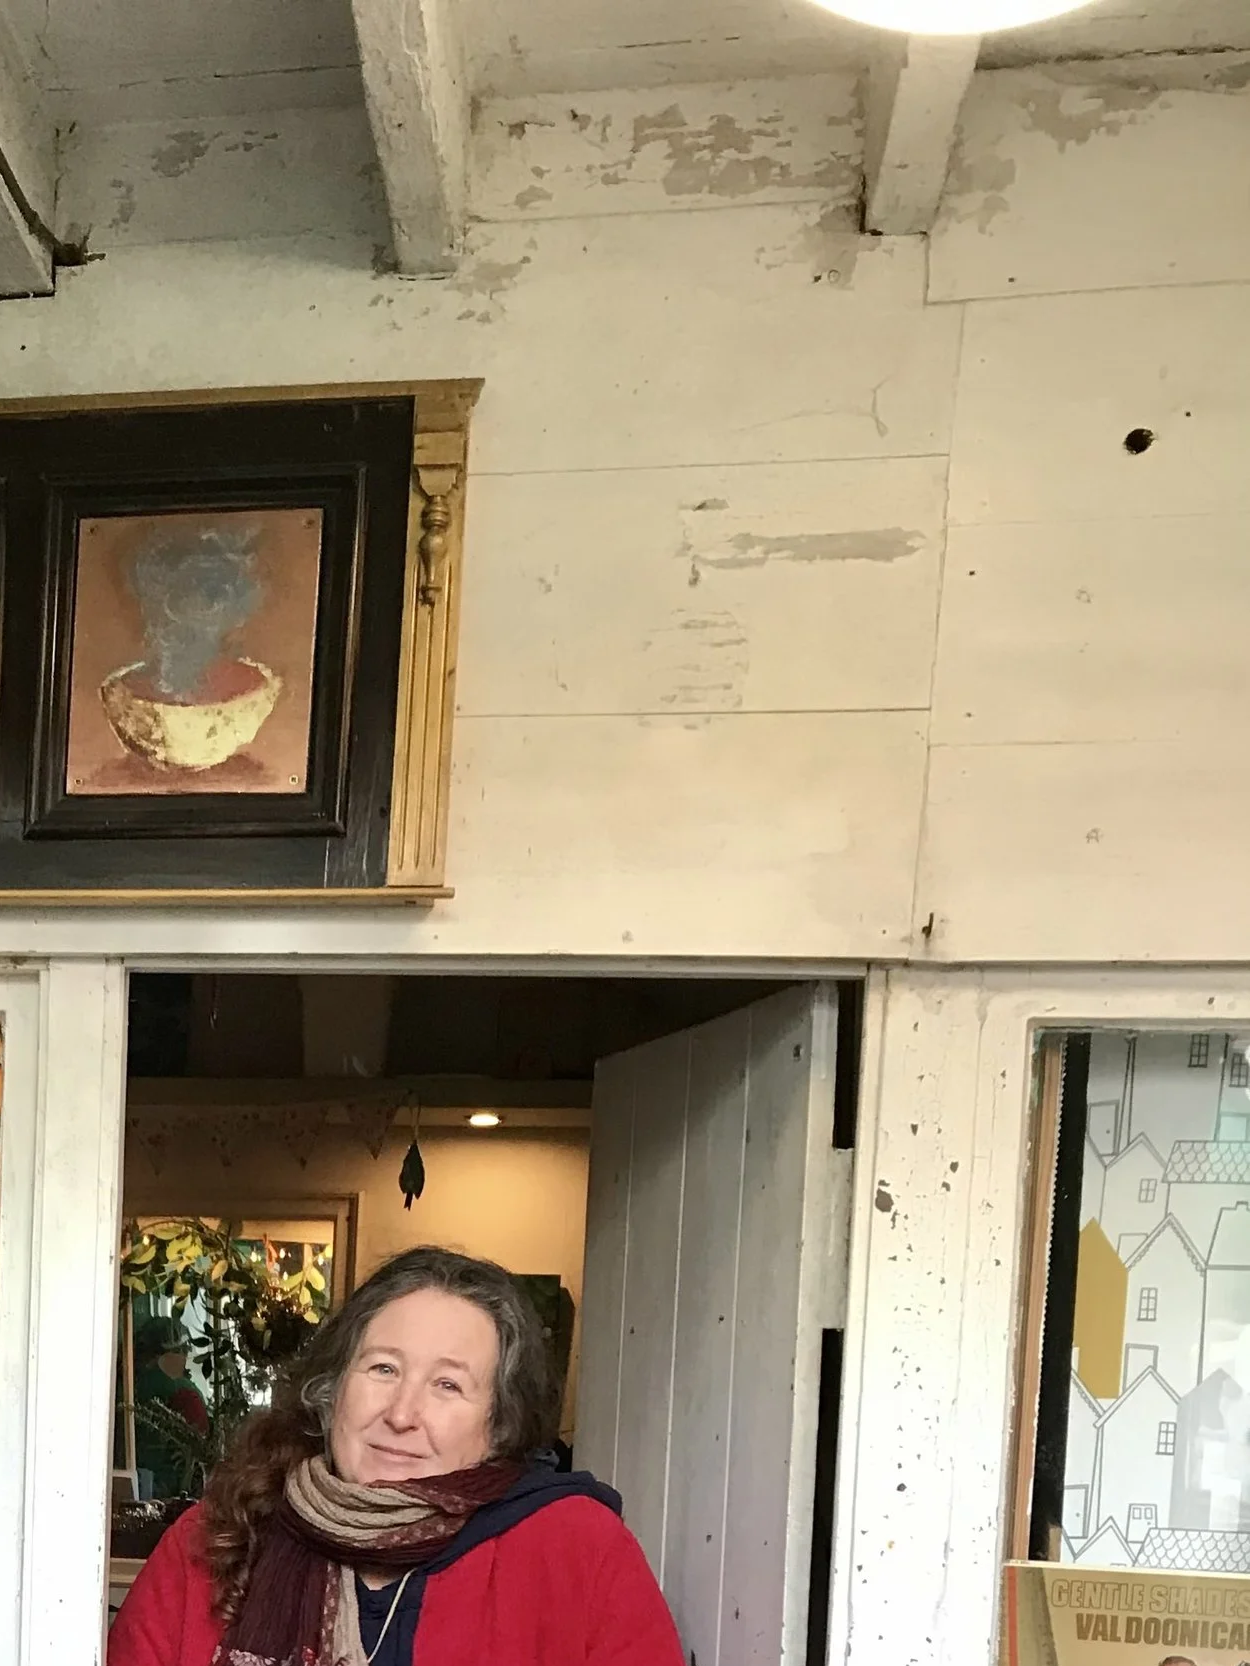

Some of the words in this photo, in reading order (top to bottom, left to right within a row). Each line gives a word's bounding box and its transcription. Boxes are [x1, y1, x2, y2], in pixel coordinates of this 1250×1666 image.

[1051, 1578, 1145, 1612] GENTLE
[1150, 1584, 1250, 1618] SHADES
[1075, 1613, 1122, 1643] VAL
[1124, 1616, 1250, 1651] DOONICA
